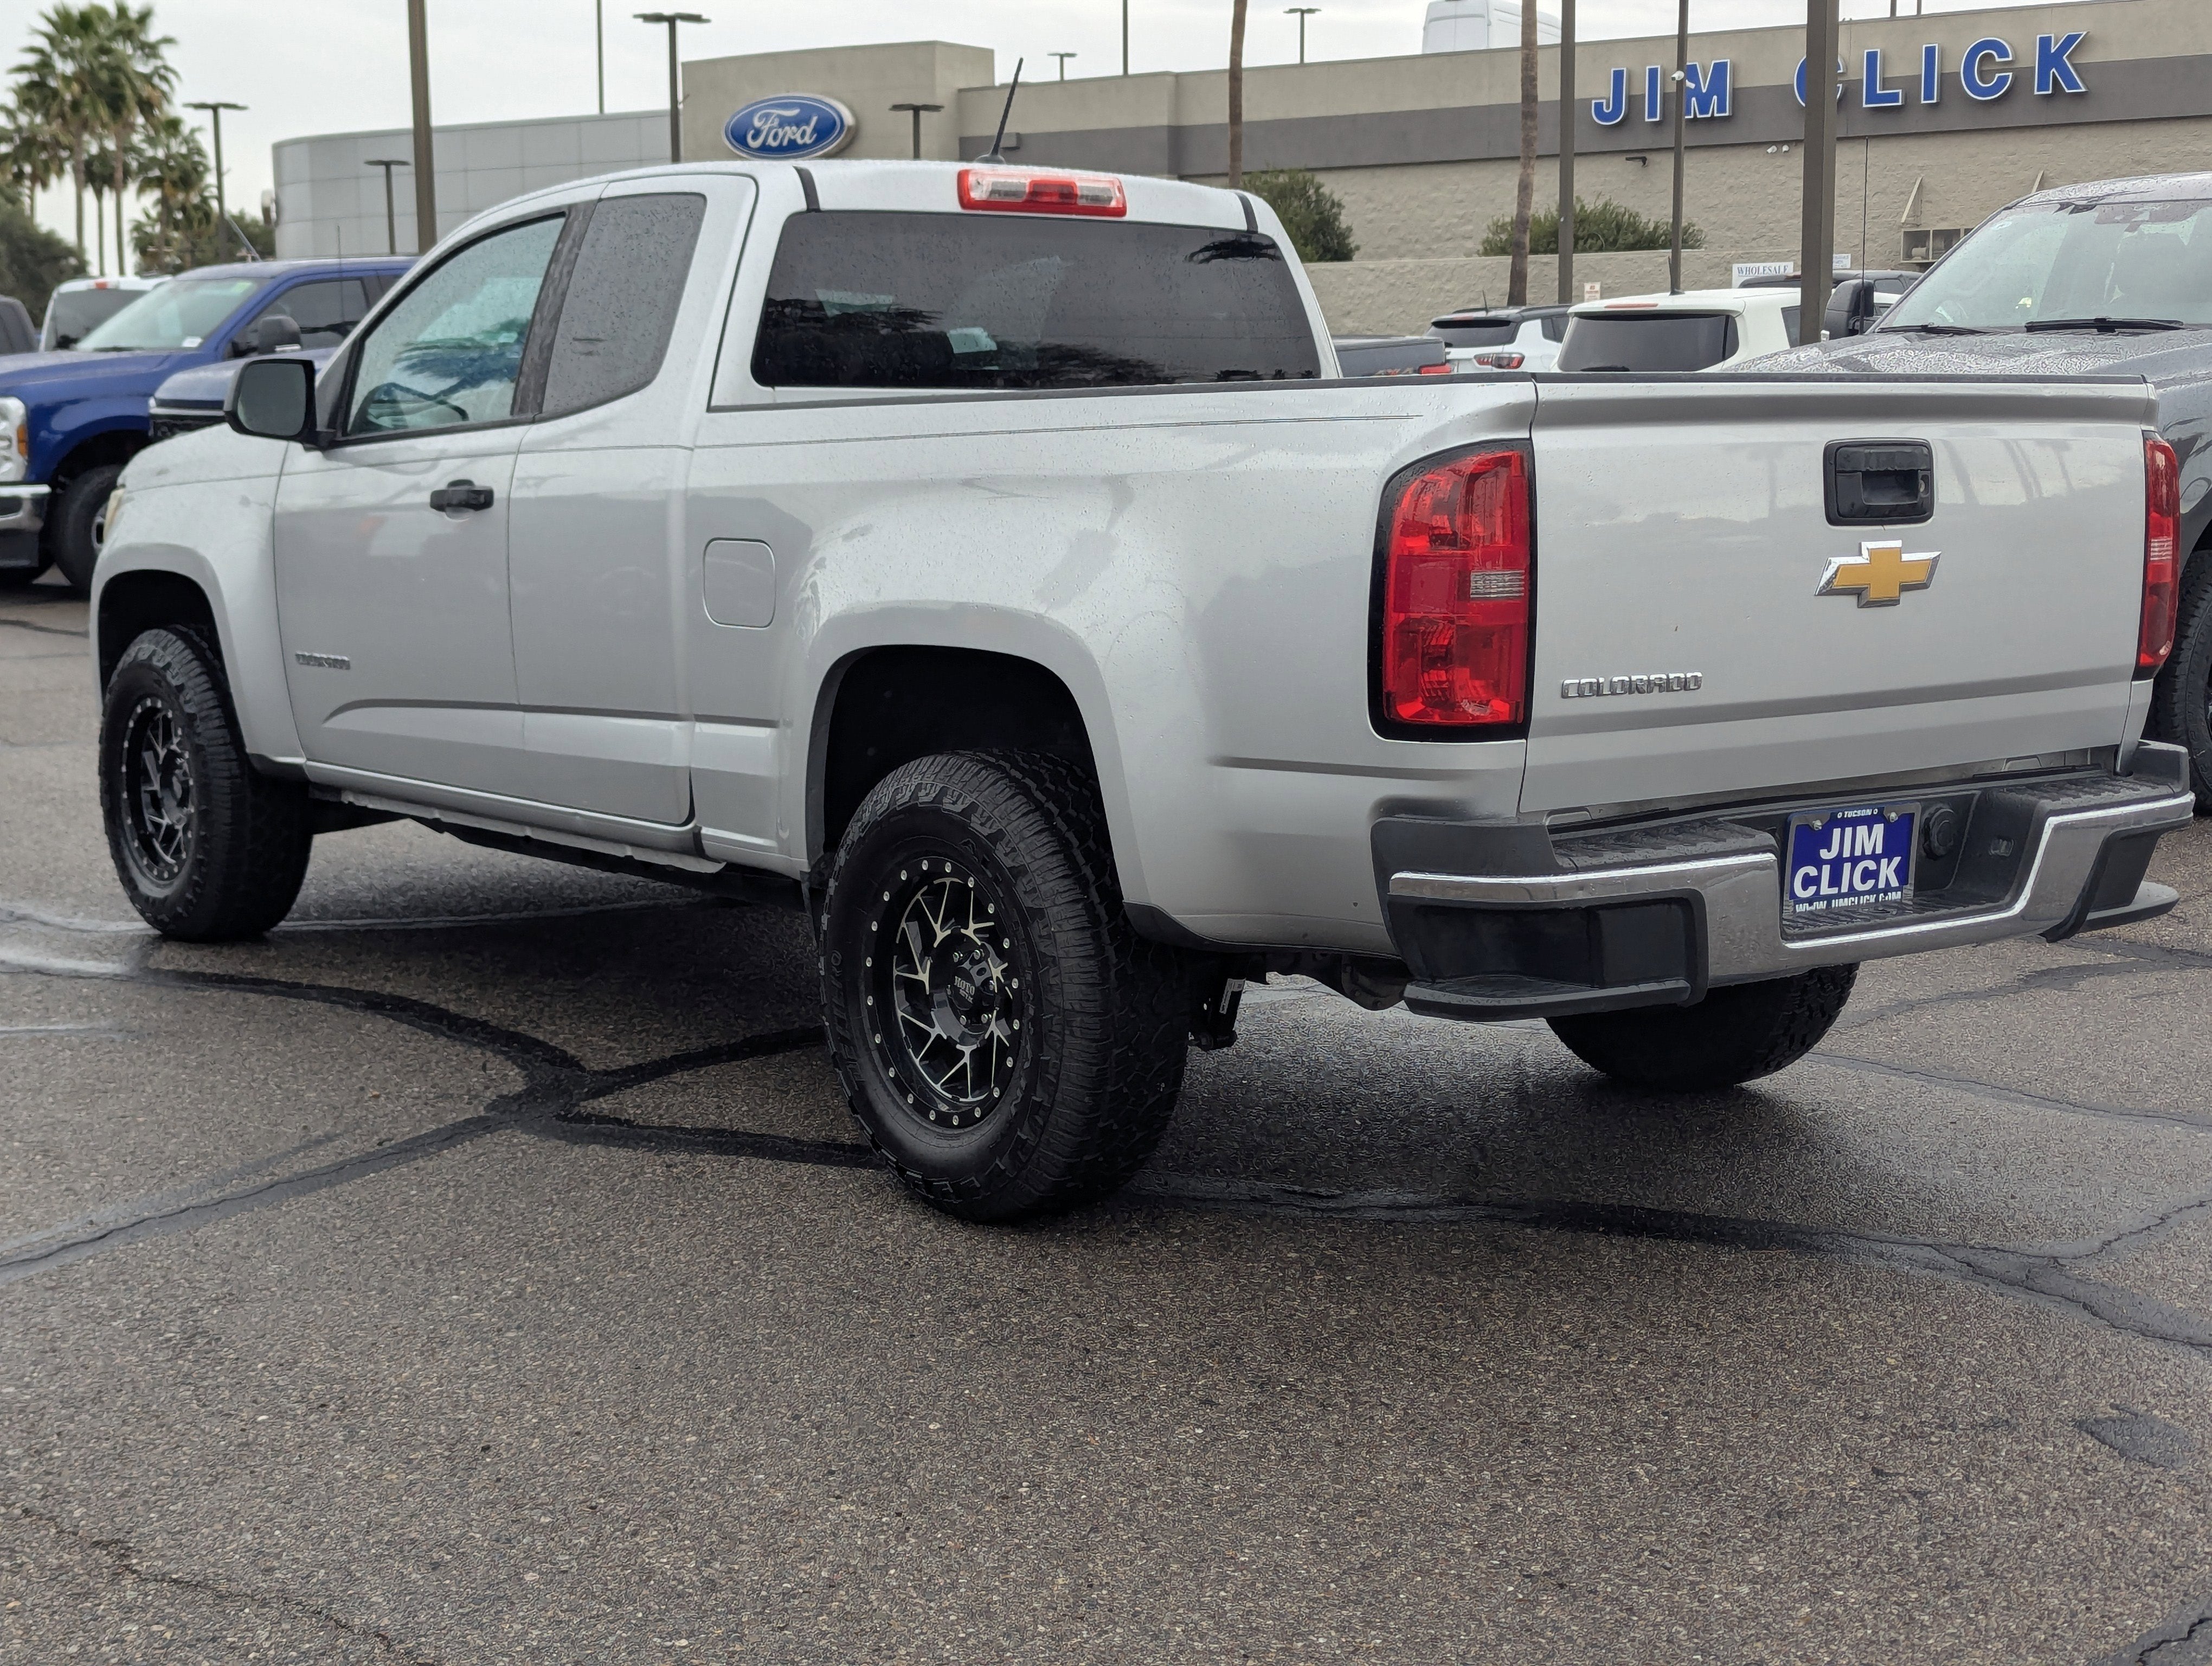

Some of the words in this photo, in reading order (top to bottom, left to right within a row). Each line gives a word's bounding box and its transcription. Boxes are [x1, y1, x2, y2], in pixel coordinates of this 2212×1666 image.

[1591, 59, 1732, 125] JIM
[746, 108, 818, 149] Ford
[1737, 265, 1789, 275] WHOLESALE
[1560, 671, 1703, 700] COLORADO
[1844, 808, 1873, 818] TUCSON
[1819, 823, 1885, 860] JIM
[1793, 856, 1902, 898] CLICK
[1795, 891, 1902, 913] WWWJIMCLICKCOM
